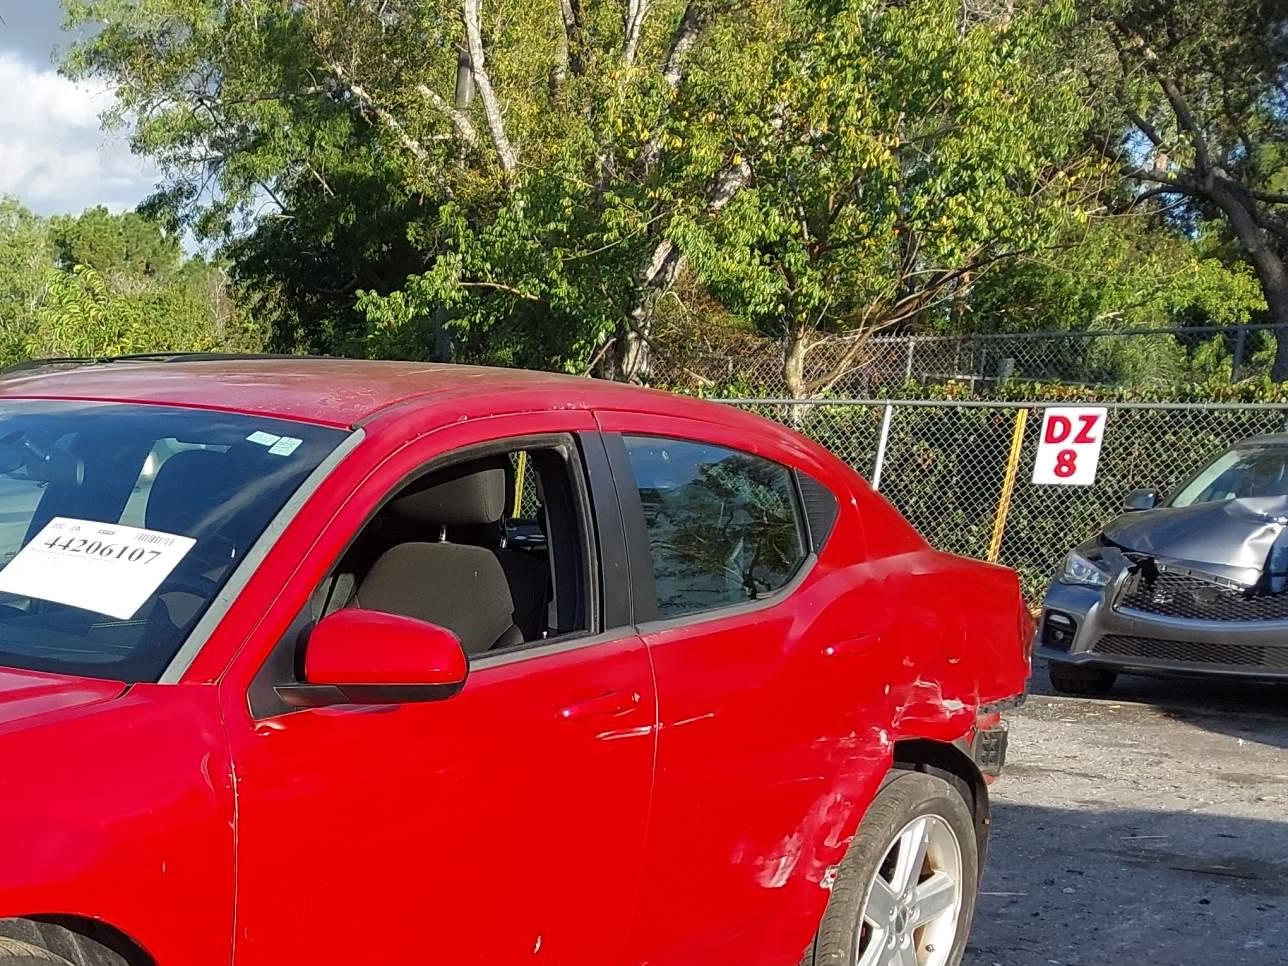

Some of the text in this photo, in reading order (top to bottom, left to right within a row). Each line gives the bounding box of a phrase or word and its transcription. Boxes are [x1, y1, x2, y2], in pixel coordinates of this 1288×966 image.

[1044, 414, 1100, 444] DZ
[1053, 449, 1077, 478] 8
[44, 535, 163, 565] 44206107
